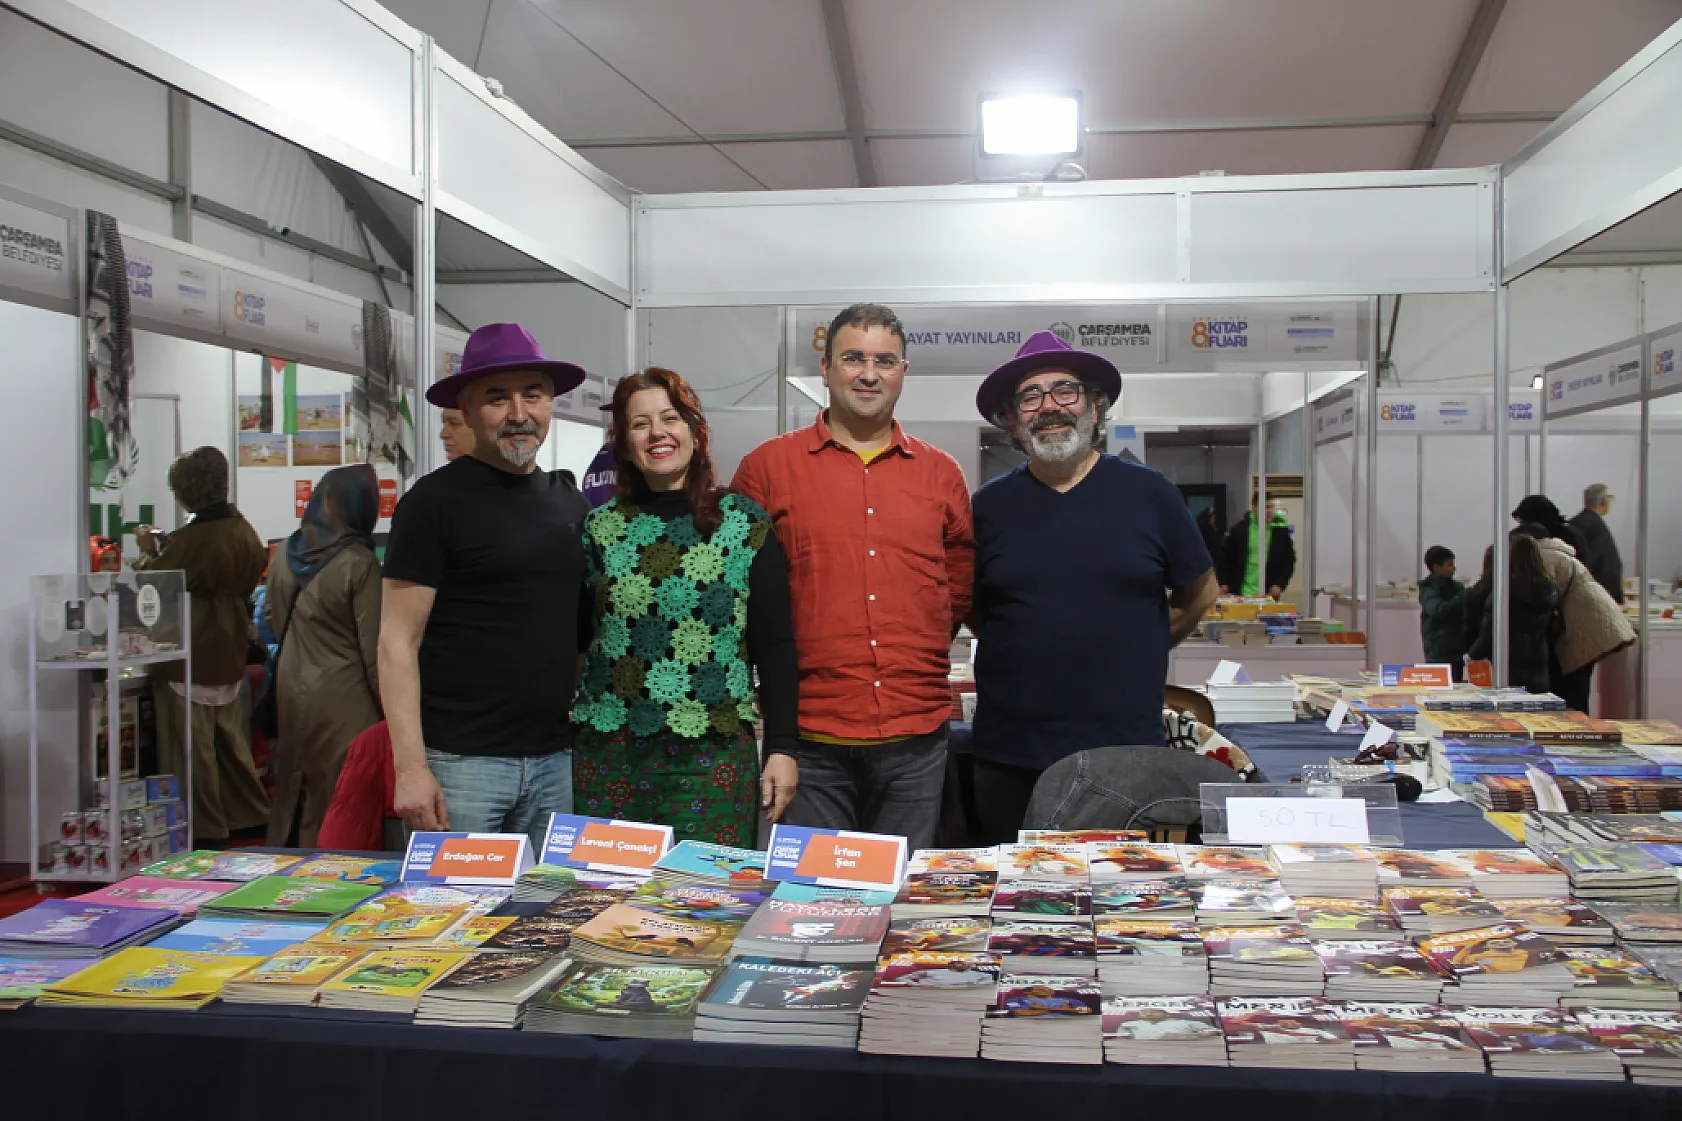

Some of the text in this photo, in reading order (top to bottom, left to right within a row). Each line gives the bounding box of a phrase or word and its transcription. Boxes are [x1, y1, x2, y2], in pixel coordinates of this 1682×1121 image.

[945, 331, 1021, 344] YAYINLARI
[1258, 806, 1346, 828] 50 TL
[581, 836, 614, 849] Levent
[442, 852, 485, 864] Erdoğan
[487, 852, 505, 862] Car
[833, 844, 861, 859] İrfan
[835, 857, 856, 869] Şen
